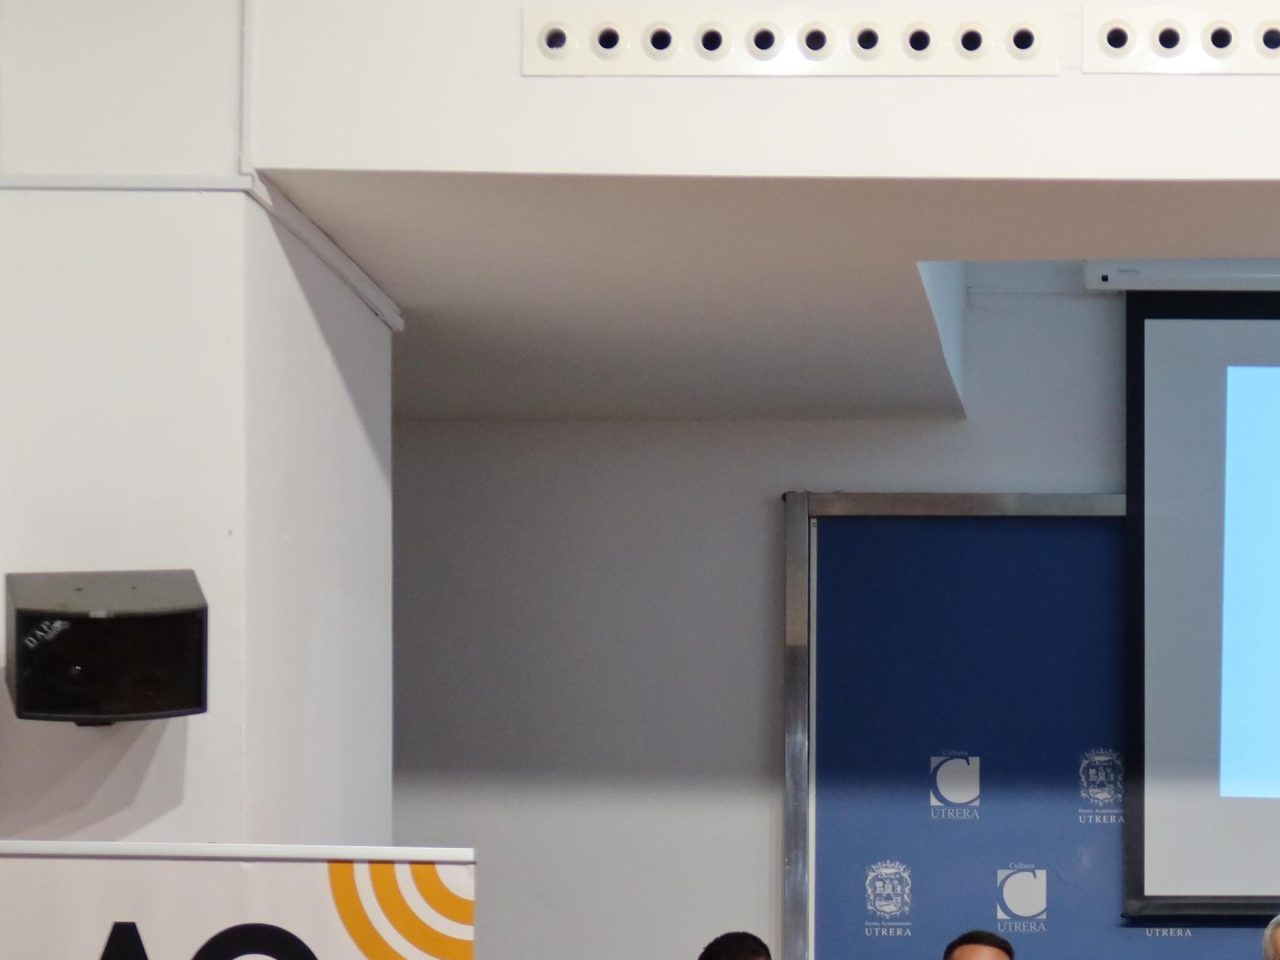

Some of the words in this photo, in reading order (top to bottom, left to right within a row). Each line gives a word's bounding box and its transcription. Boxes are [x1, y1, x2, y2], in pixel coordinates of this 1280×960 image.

[930, 808, 981, 819] UTRERA
[1078, 815, 1126, 824] UTRERA
[997, 921, 1047, 932] UTRERA
[865, 927, 912, 936] UTRERA
[1145, 928, 1192, 937] UTRERA
